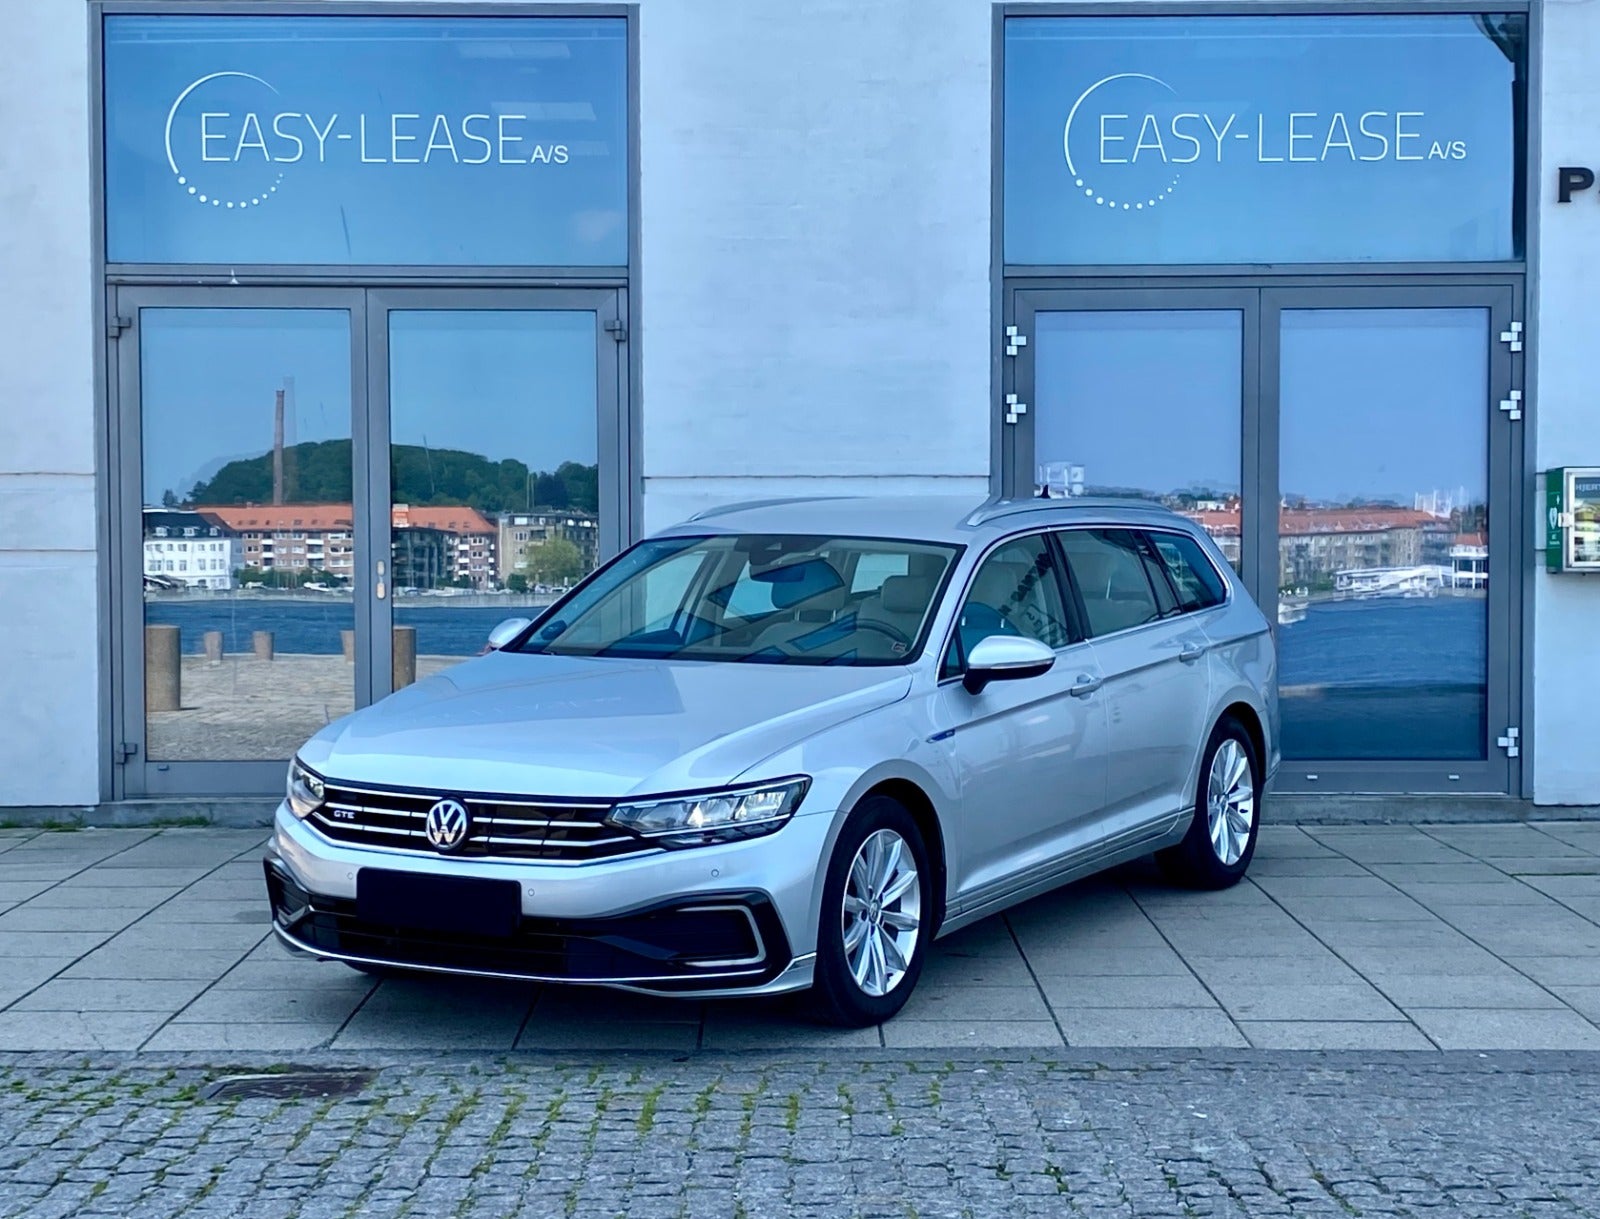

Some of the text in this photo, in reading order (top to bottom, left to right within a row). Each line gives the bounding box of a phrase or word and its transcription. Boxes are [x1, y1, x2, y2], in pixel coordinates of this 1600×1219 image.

[201, 112, 569, 164] EASY-LEASE A/S
[1099, 111, 1467, 163] EASY-LEASE A/S
[1557, 166, 1600, 203] P
[333, 809, 355, 819] GTE
[426, 799, 468, 850] VW
